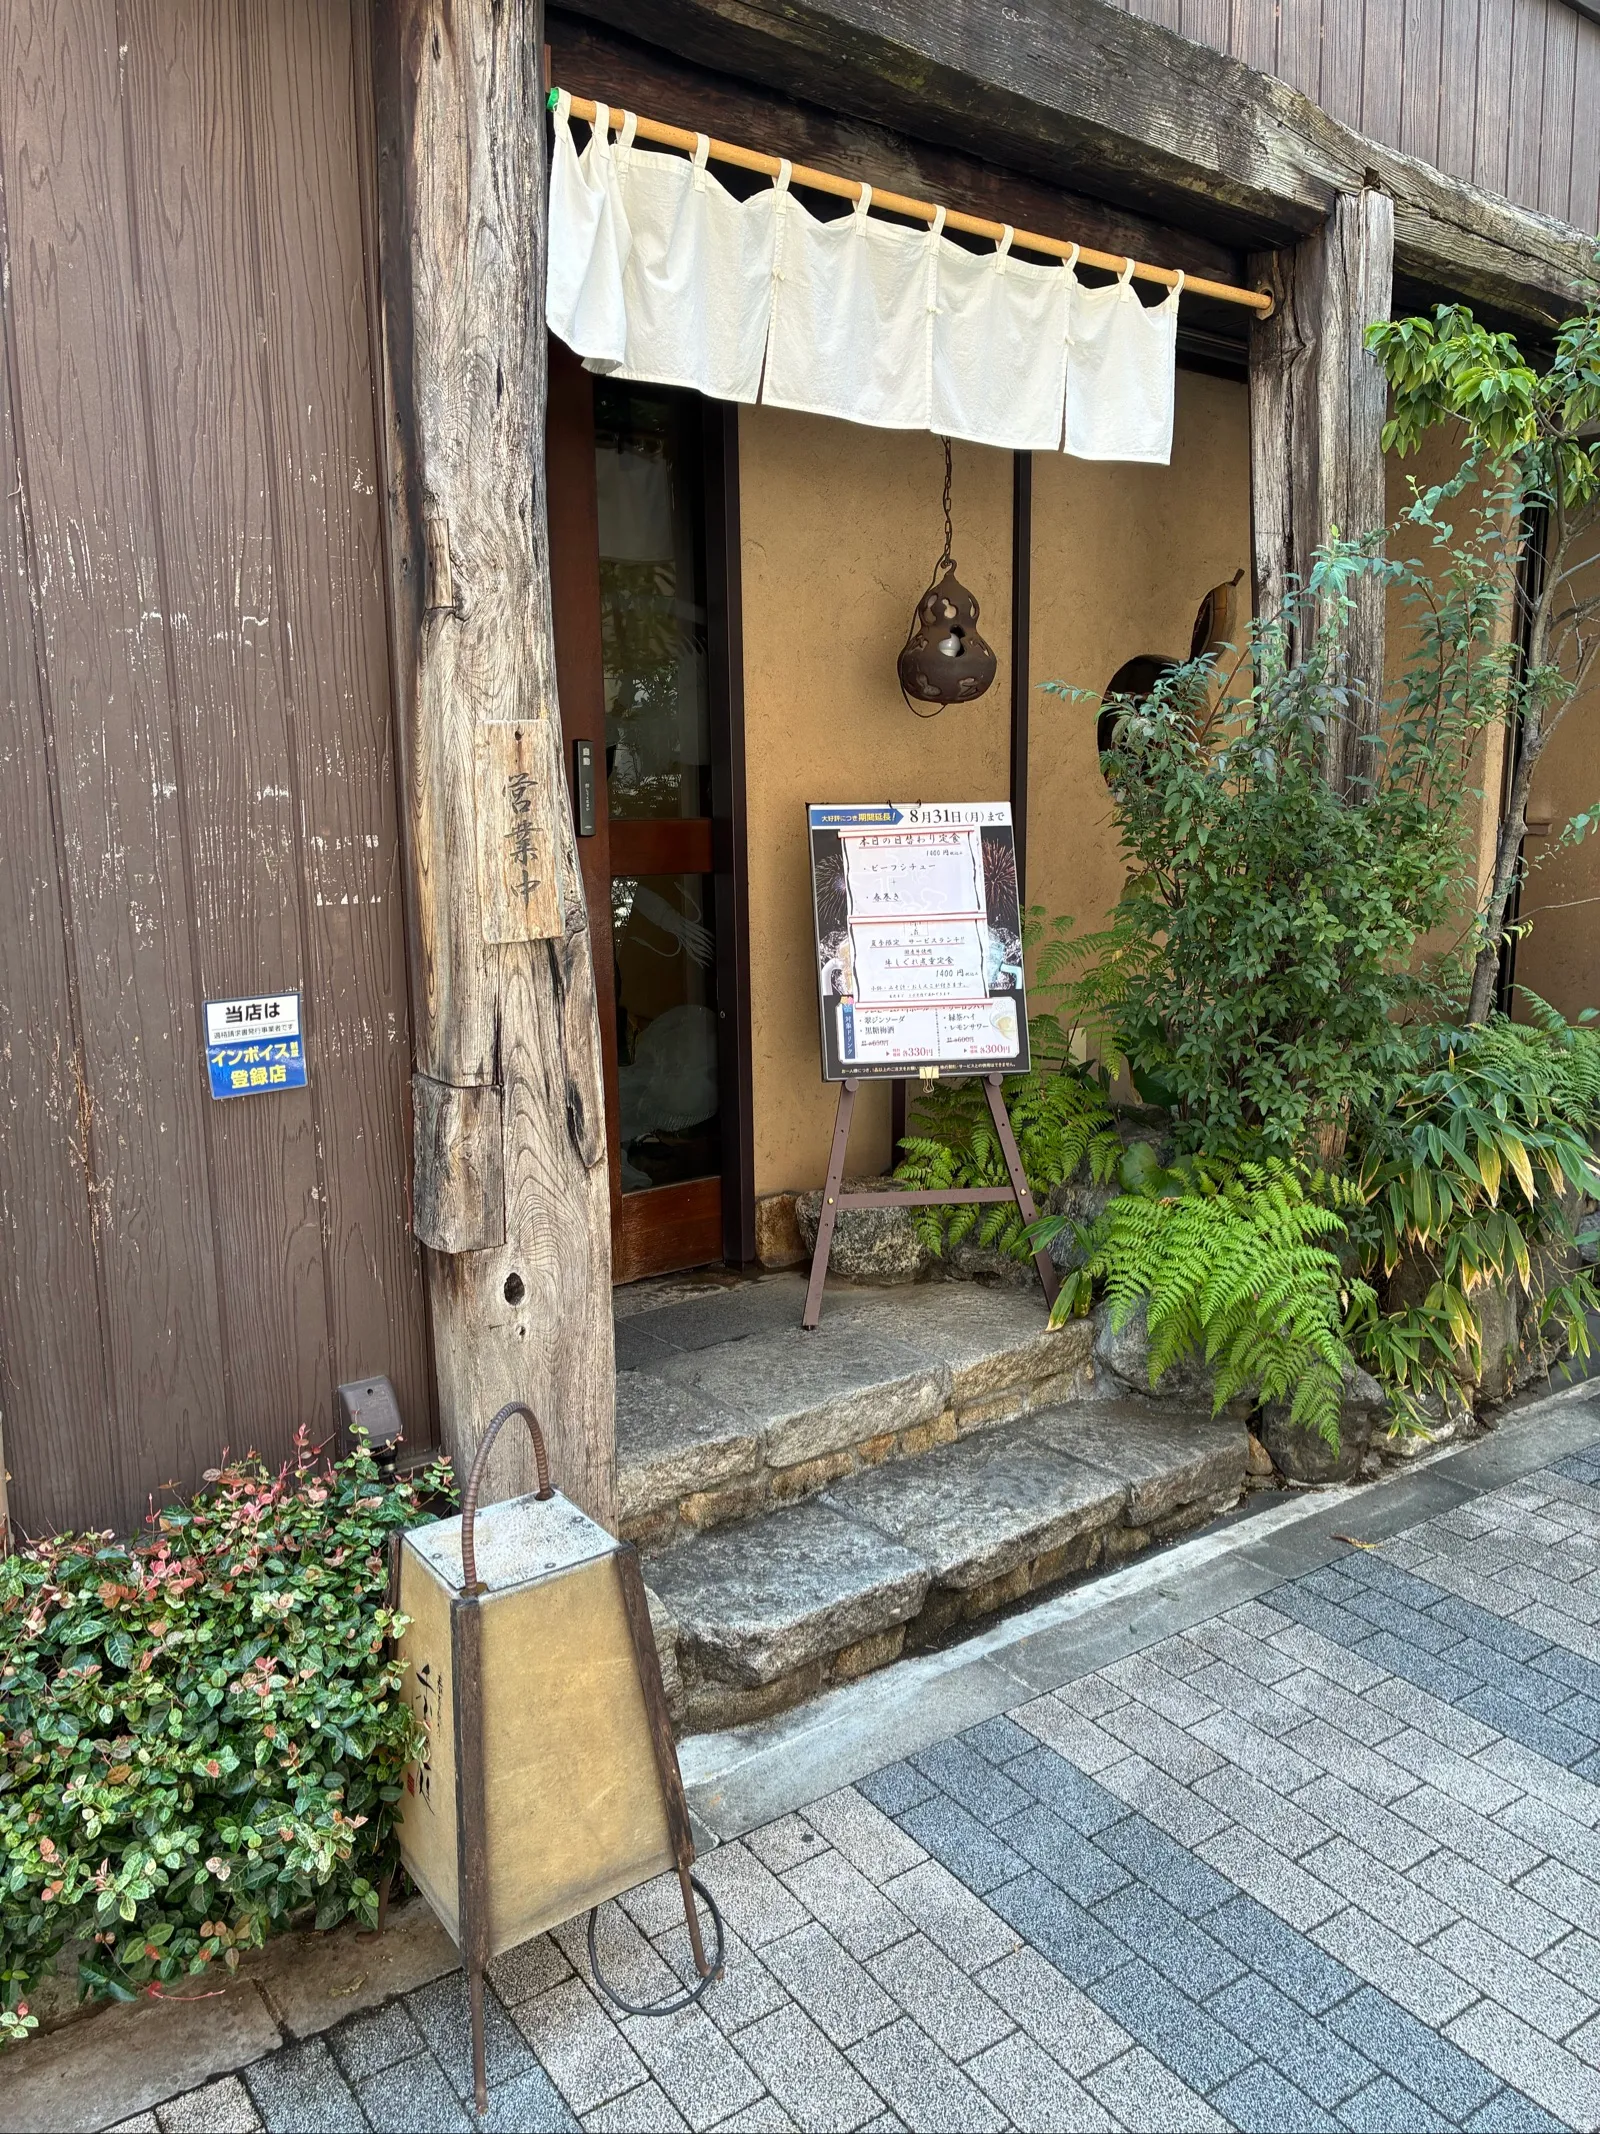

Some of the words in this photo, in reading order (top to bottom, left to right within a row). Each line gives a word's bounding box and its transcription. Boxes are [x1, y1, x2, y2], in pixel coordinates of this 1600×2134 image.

[502, 772, 543, 906] 営業中
[859, 833, 961, 847] 本日の日替わり定食
[225, 1002, 280, 1023] 当店は
[213, 1023, 294, 1039] 適格請求書発行事業者です
[845, 1016, 853, 1056] 対象ドリンク
[230, 1064, 287, 1089] 登録店
